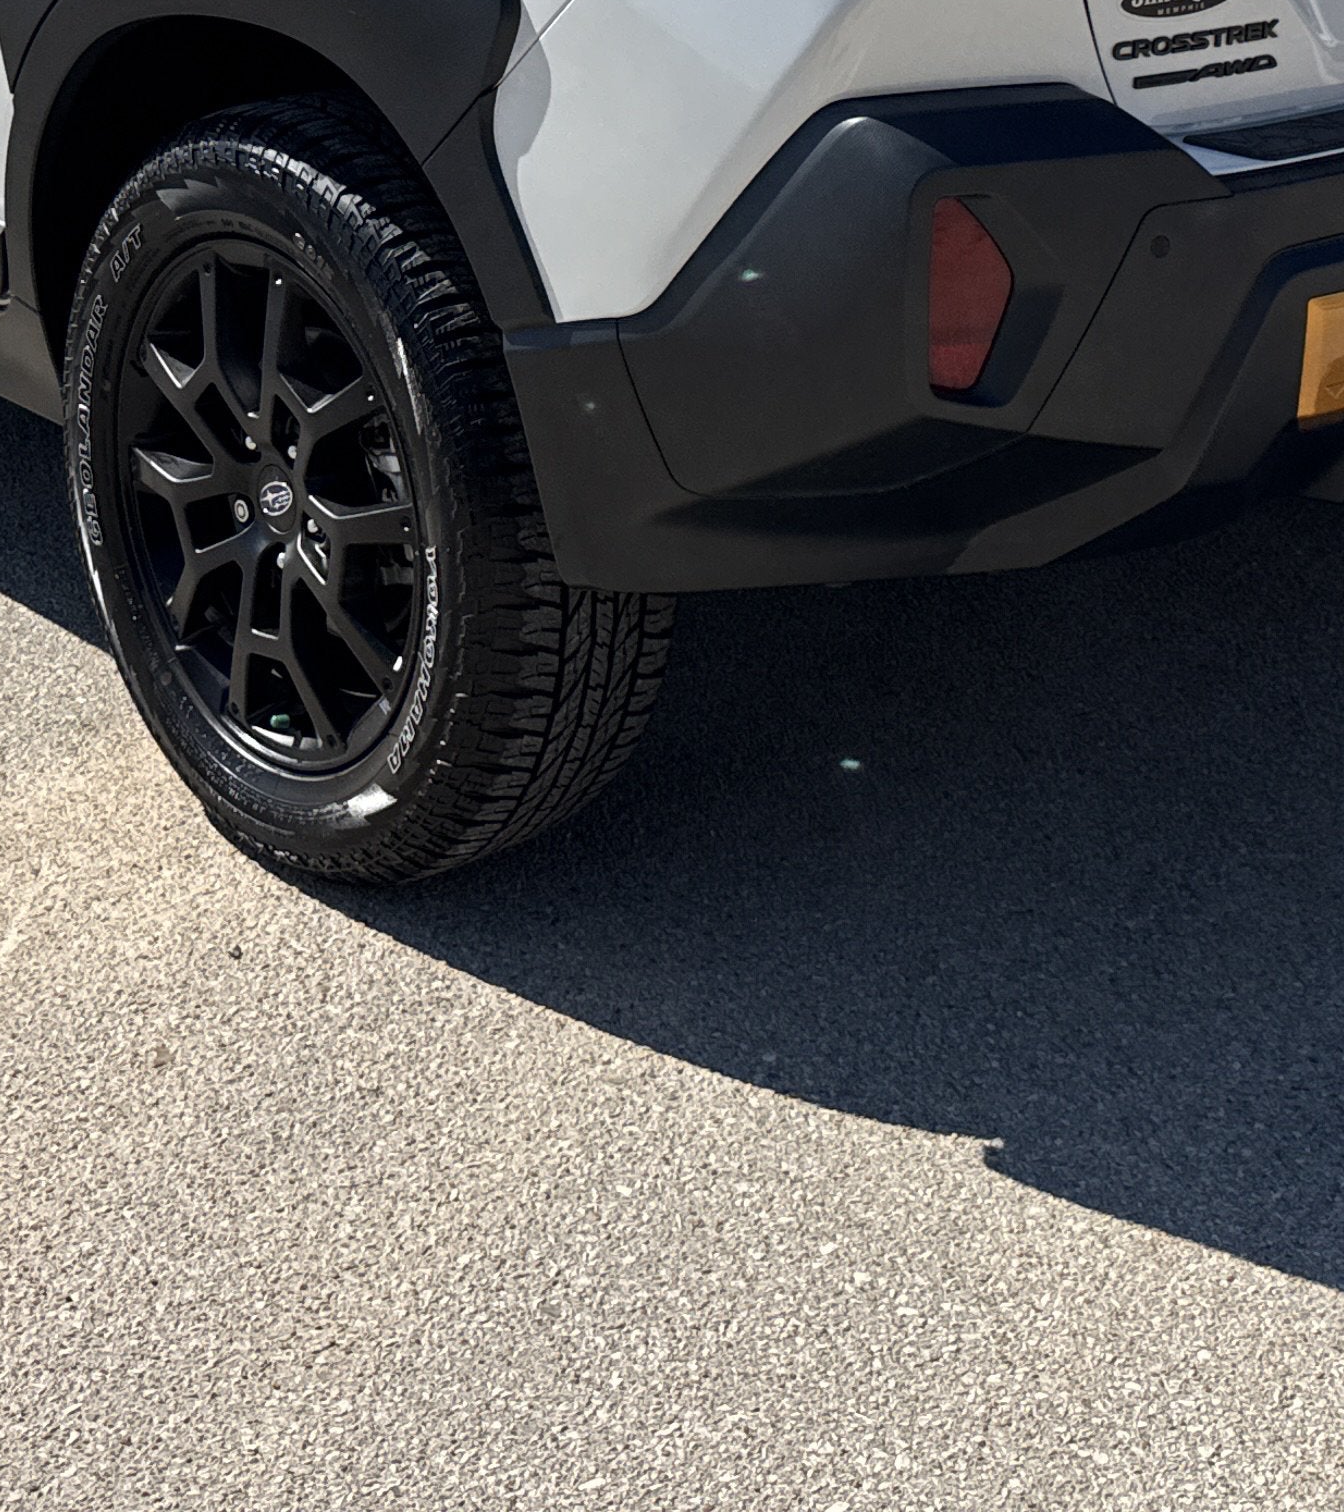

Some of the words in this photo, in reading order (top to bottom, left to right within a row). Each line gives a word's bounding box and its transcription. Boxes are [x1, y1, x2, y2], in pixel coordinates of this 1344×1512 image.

[1157, 2, 1205, 15] MEMPHIS
[1112, 19, 1279, 61] CROSSTREK
[1190, 54, 1278, 82] AWD
[109, 222, 143, 283] A/T
[77, 294, 109, 547] GEOLANDAR
[387, 544, 440, 775] YOKOHAMA
